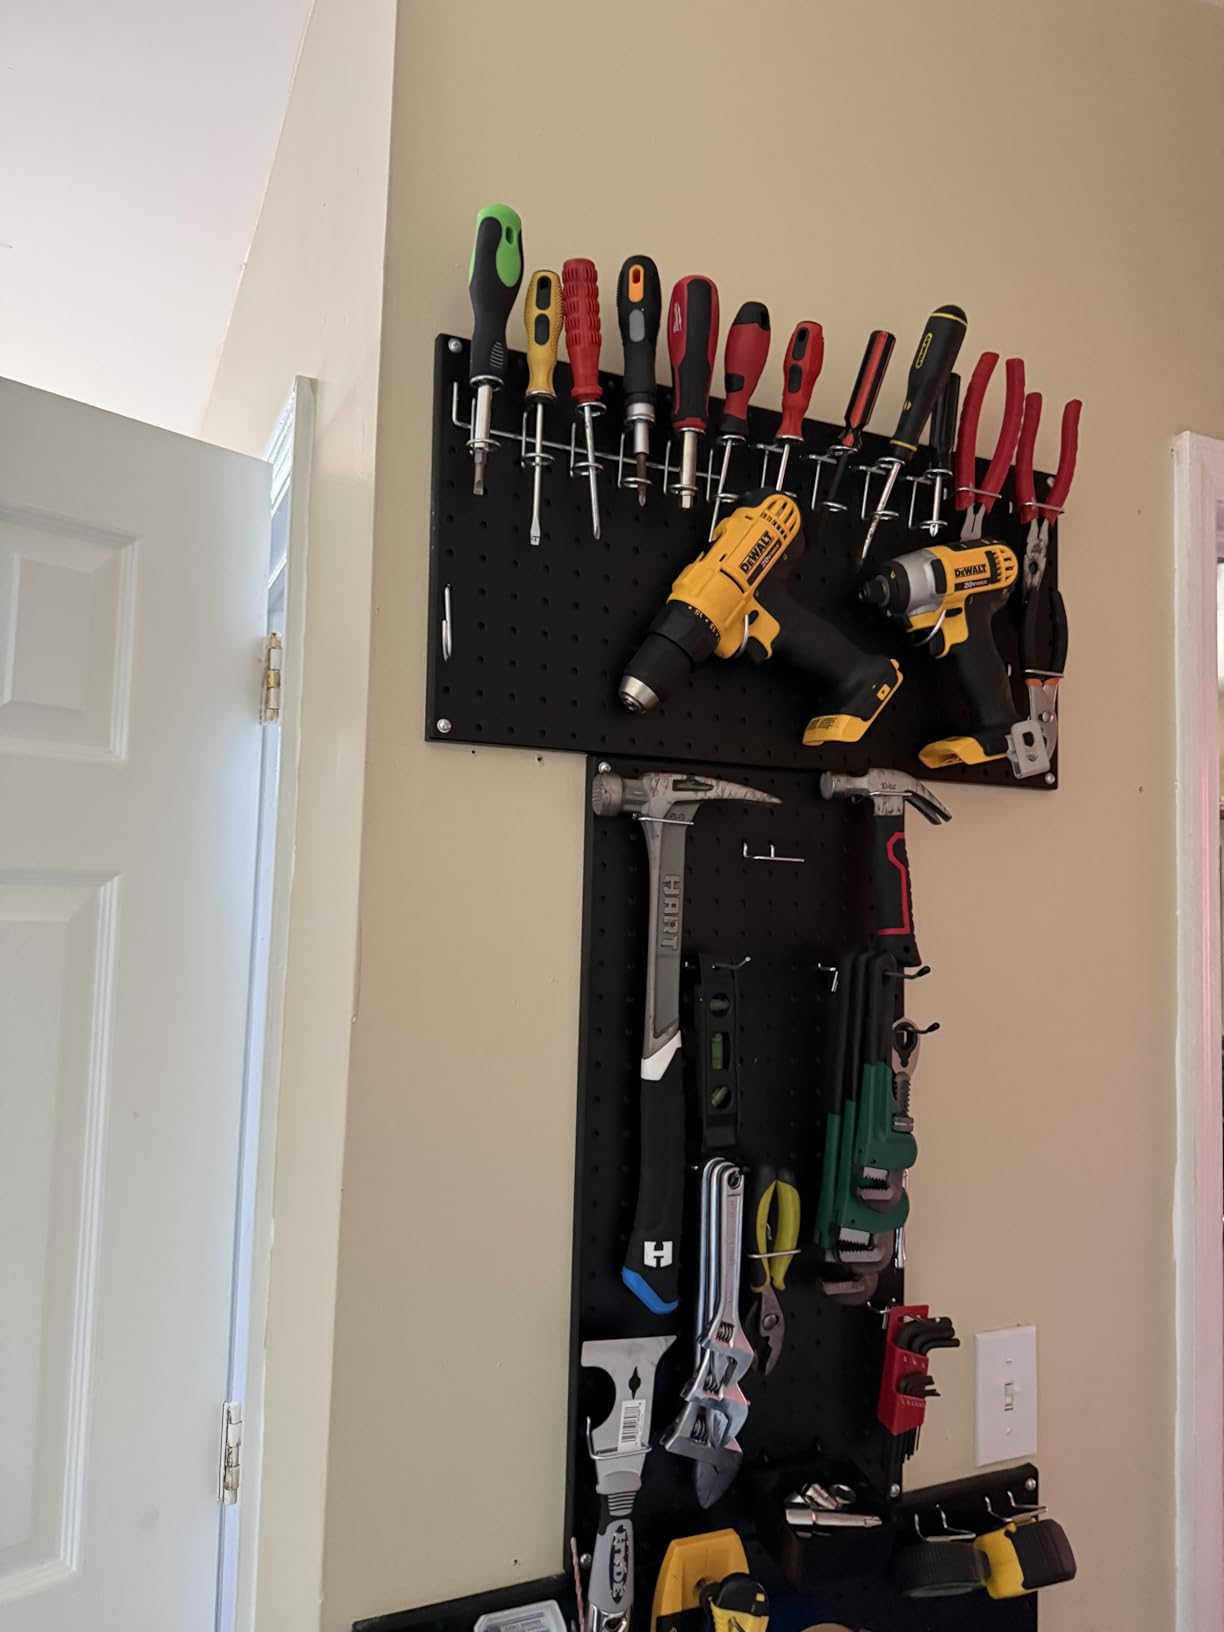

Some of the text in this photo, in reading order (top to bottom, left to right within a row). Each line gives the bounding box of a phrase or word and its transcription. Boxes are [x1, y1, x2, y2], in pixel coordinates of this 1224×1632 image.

[739, 530, 773, 575] DEWALT
[954, 564, 987, 578] DEWALT
[660, 874, 682, 951] HART
[643, 1241, 673, 1268] H
[611, 1532, 628, 1598] HYDE
